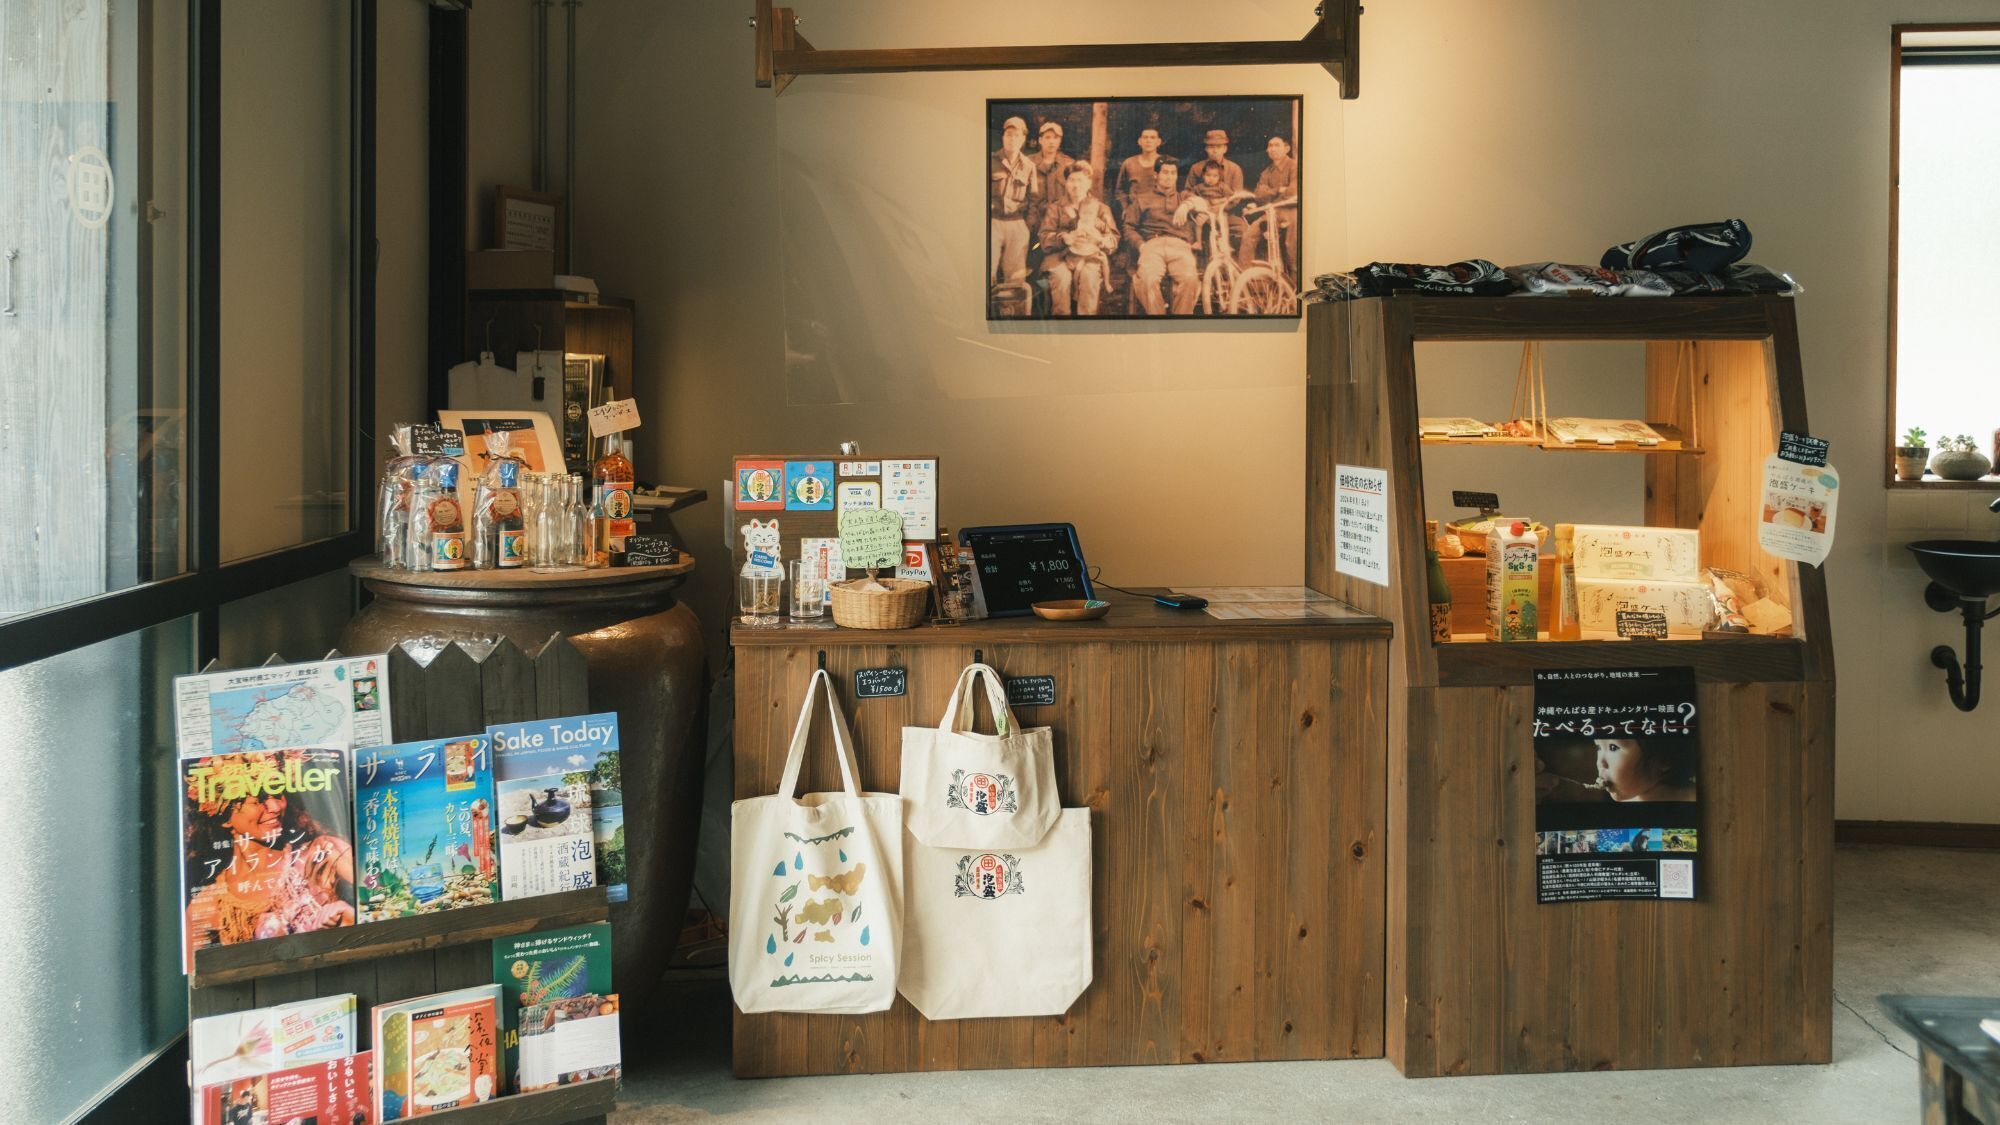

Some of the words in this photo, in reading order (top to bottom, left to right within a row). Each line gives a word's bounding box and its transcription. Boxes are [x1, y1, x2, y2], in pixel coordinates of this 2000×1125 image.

[1340, 475, 1382, 491] 価格改定のお知らせ
[1533, 702, 1696, 737] たべるってなに?
[1538, 704, 1675, 715] 沖縄やんばる産ドキュメンタリー映画
[493, 728, 544, 751] Sake
[550, 720, 614, 745] Today
[359, 739, 488, 785] サライ
[188, 758, 341, 803] Traveller
[975, 790, 988, 814] 泡盛
[233, 828, 306, 850] サザン
[204, 842, 334, 879] アイランズが
[982, 873, 995, 898] 泡盛
[809, 953, 835, 964] Spicy
[837, 953, 872, 963] Session
